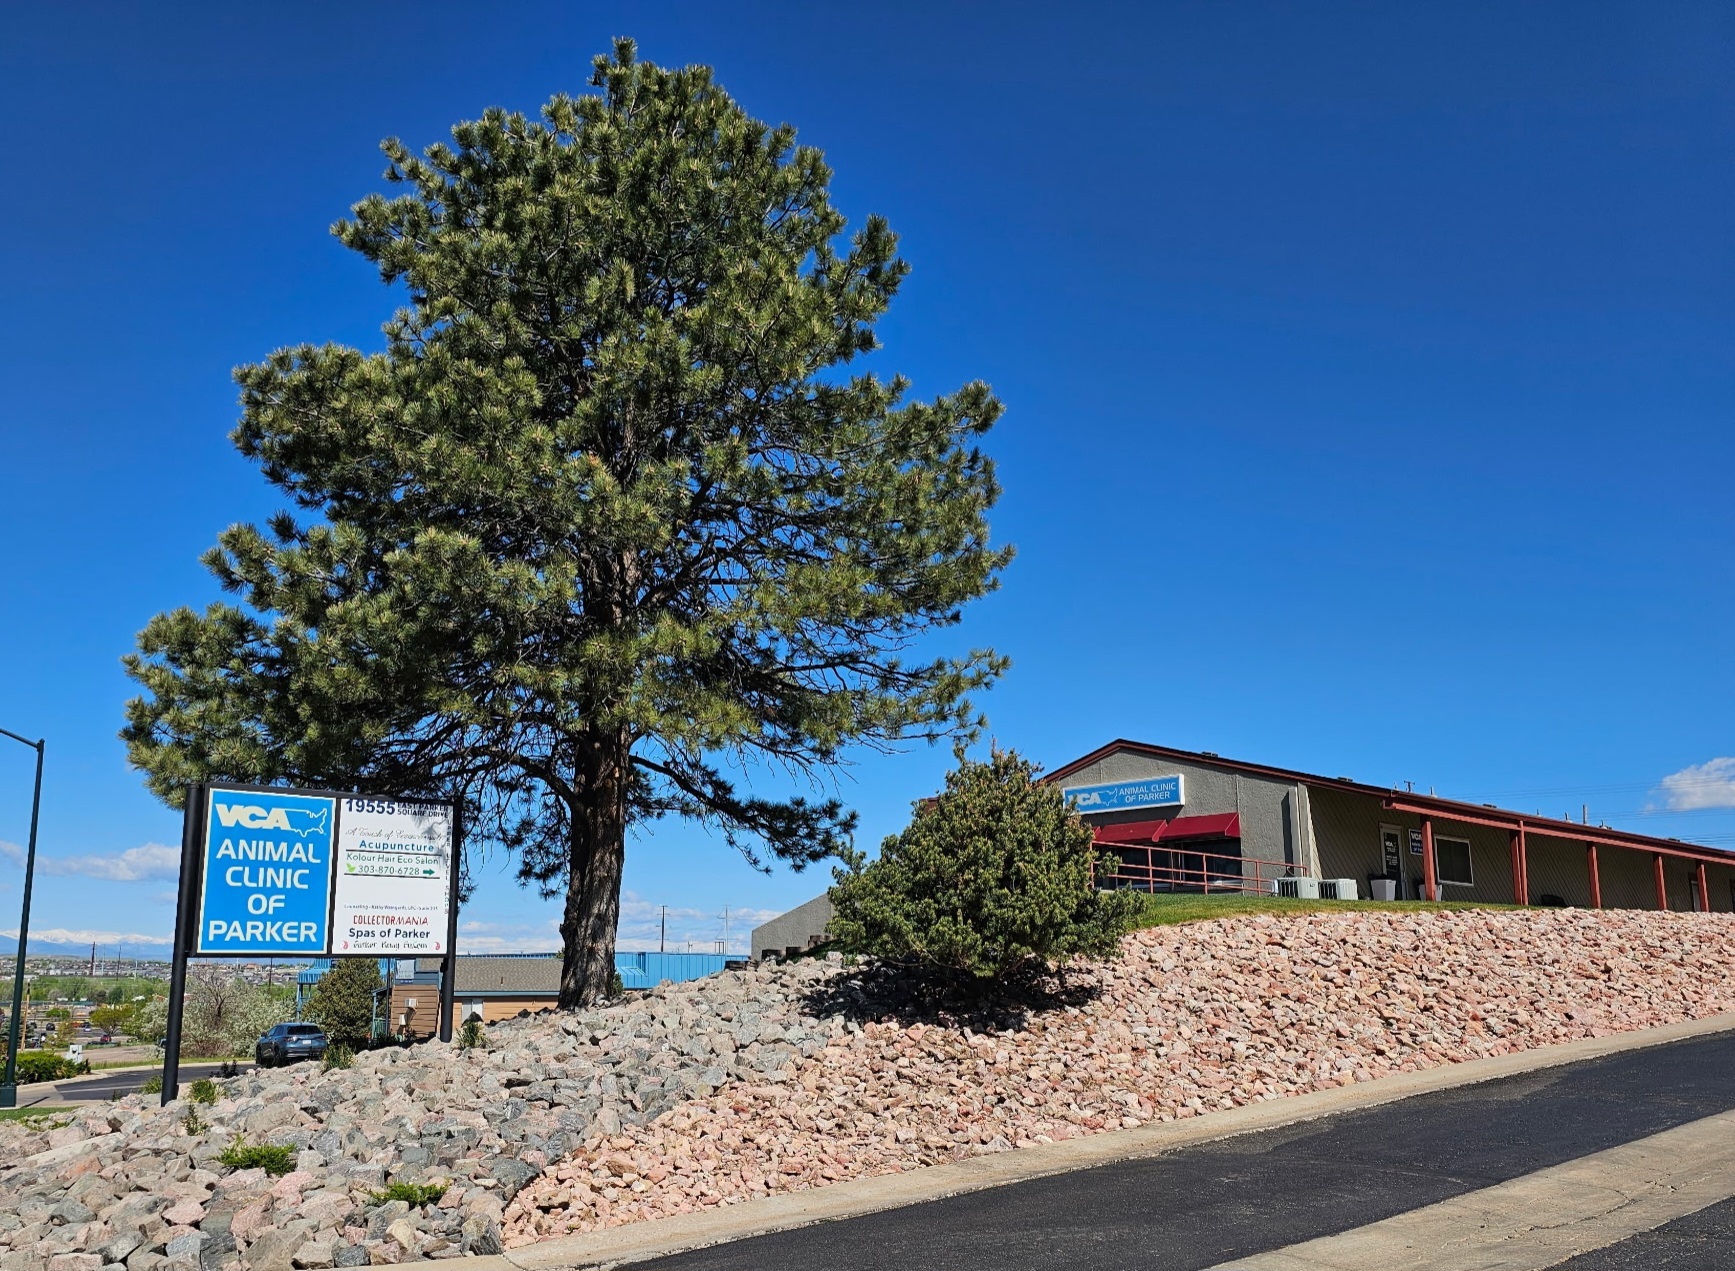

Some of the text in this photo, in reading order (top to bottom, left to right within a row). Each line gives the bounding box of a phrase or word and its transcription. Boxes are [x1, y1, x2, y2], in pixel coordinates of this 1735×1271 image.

[1118, 782, 1176, 796] ANIMAL CLINIC
[1125, 791, 1171, 804] OF PARKER
[345, 798, 449, 815] 19555 EAST PARKER
[215, 803, 292, 831] VCA
[398, 808, 449, 819] SQUARE DRIVE
[215, 838, 322, 864] ANIMAL
[359, 840, 434, 852] Acupuncture
[346, 852, 439, 865] Kolour Hair Eco Salon
[358, 865, 420, 876] 303-870-6728
[225, 866, 310, 890] CLINIC
[247, 893, 286, 915] OF
[353, 914, 428, 926] COLLECTORMANIA
[208, 920, 318, 943] PARKER
[348, 927, 430, 939] Spas of Parker
